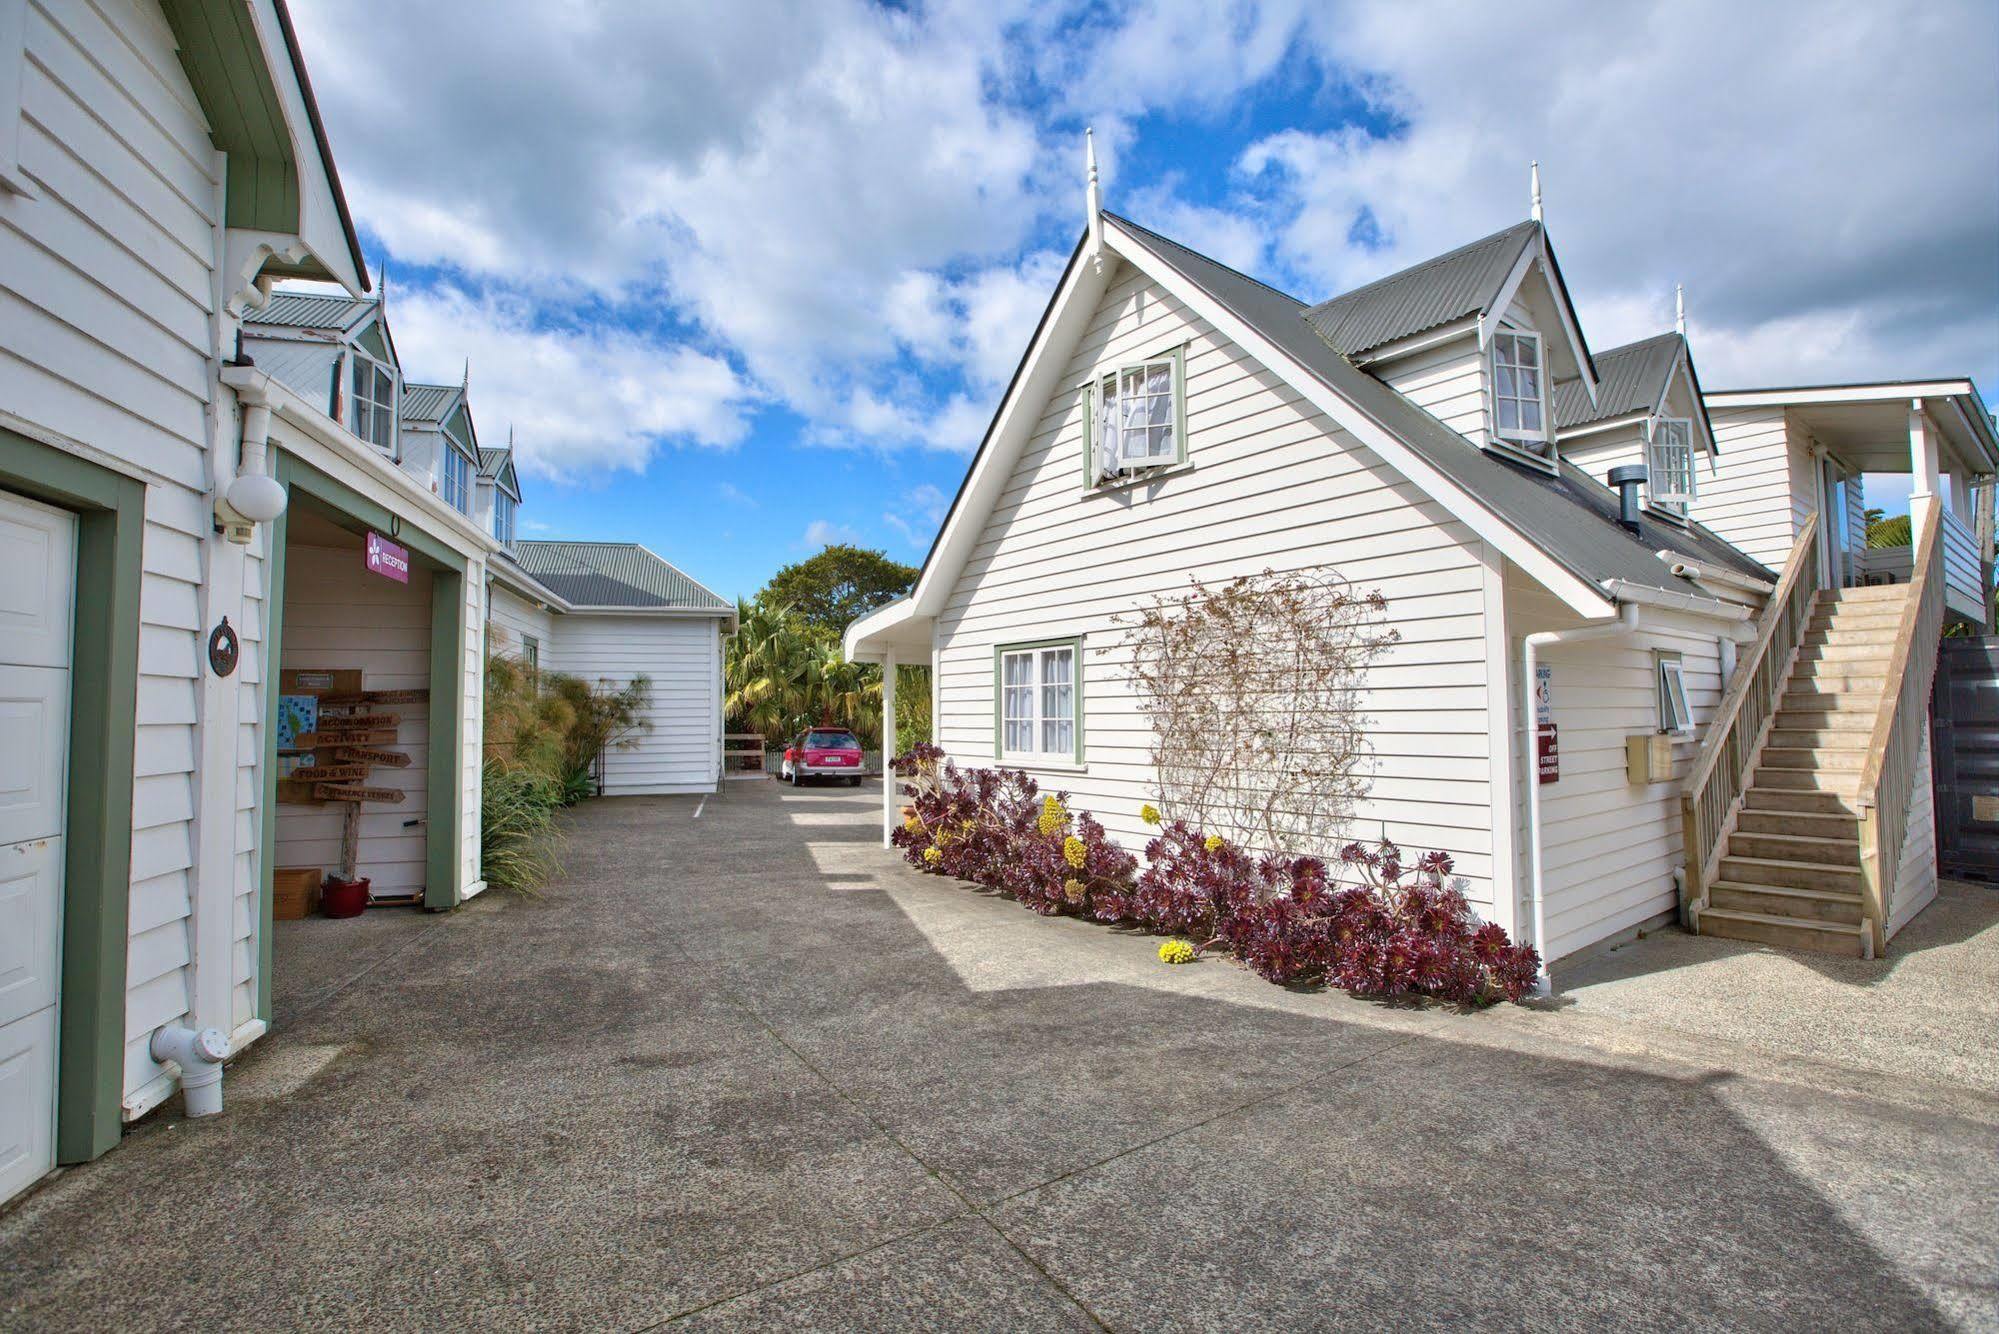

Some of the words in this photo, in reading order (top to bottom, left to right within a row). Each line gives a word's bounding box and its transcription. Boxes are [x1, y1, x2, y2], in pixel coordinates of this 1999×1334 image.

[382, 552, 408, 572] RECEPTION
[343, 748, 400, 764] TRANSPORT
[1540, 755, 1558, 765] STREET
[299, 768, 327, 778] FOOD
[328, 769, 337, 778] &
[339, 766, 366, 777] WINE
